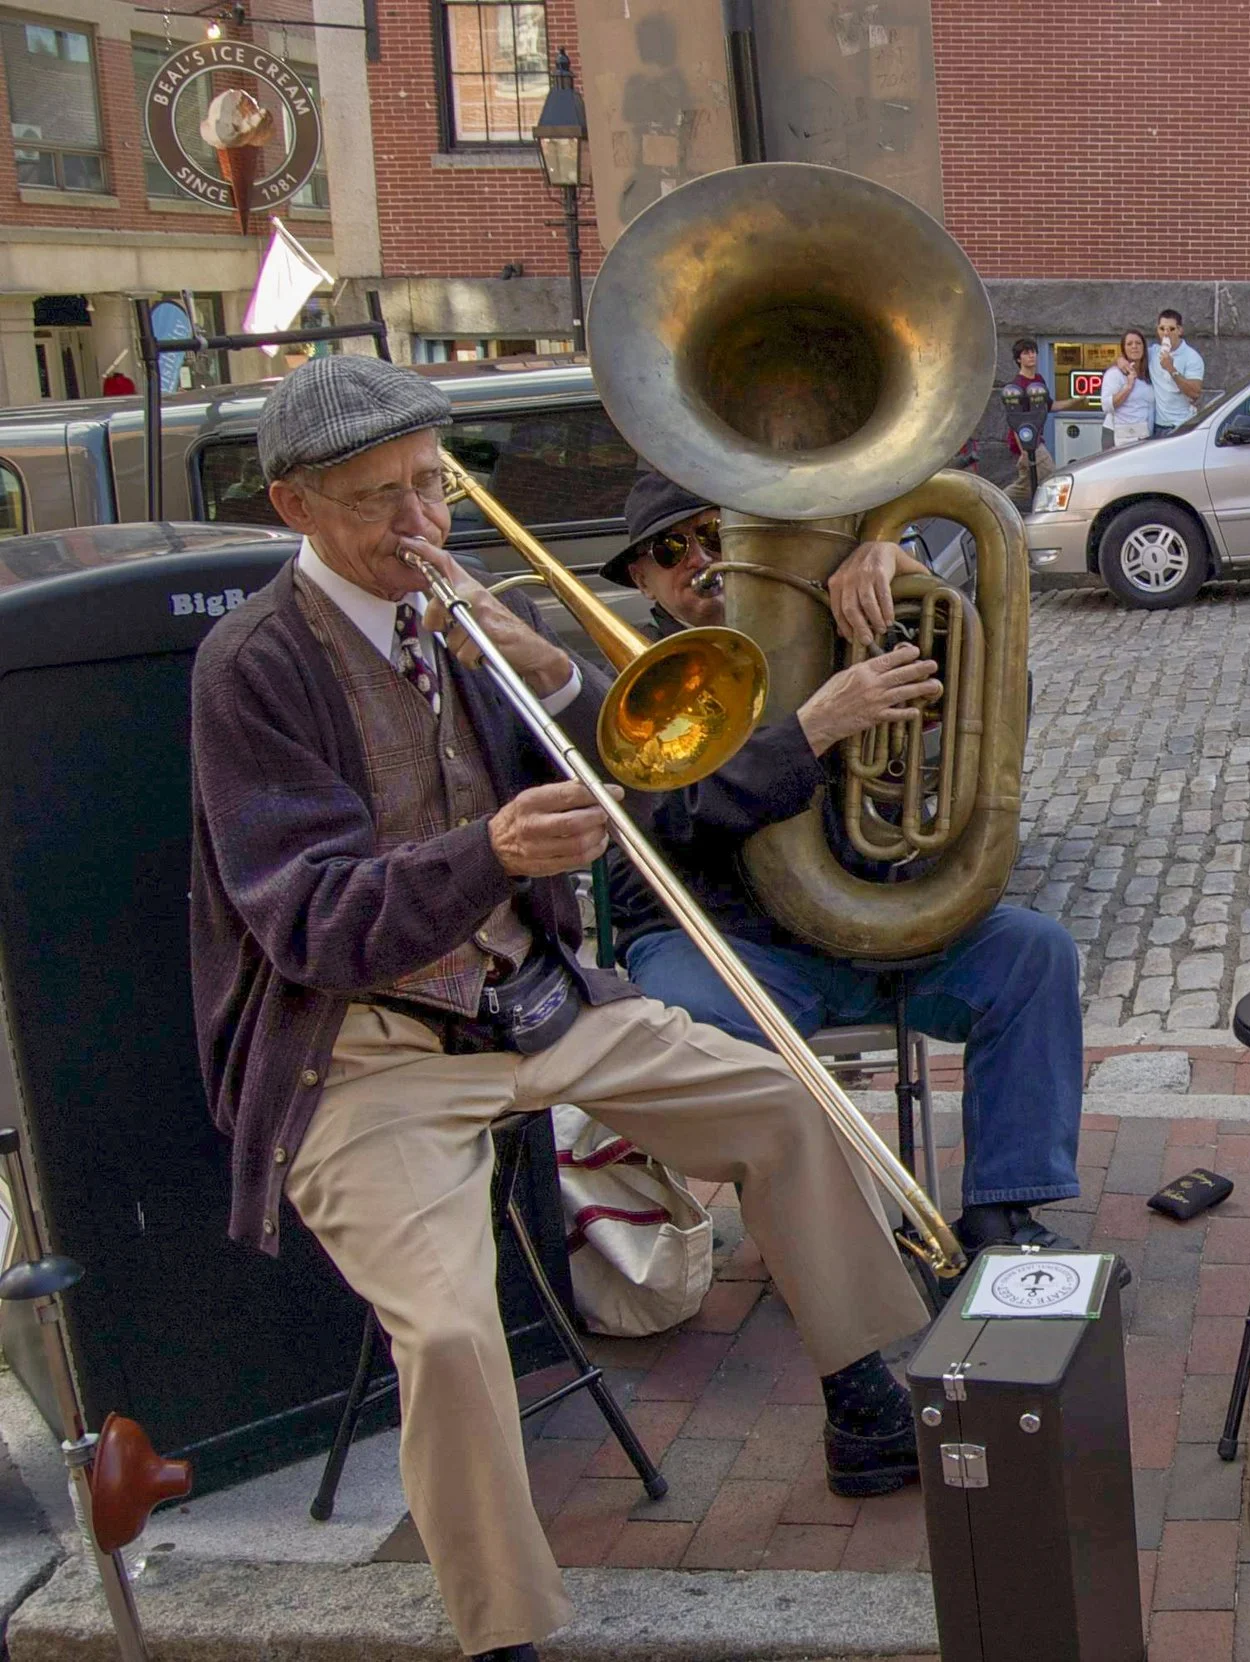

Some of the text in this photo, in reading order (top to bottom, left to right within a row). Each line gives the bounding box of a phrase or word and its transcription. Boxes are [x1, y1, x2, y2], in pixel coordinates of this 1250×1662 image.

[153, 46, 311, 116] BEAL'S ICE CREAM
[176, 167, 298, 203] SINCE 1981
[1075, 375, 1102, 395] OP
[171, 588, 246, 617] BigB
